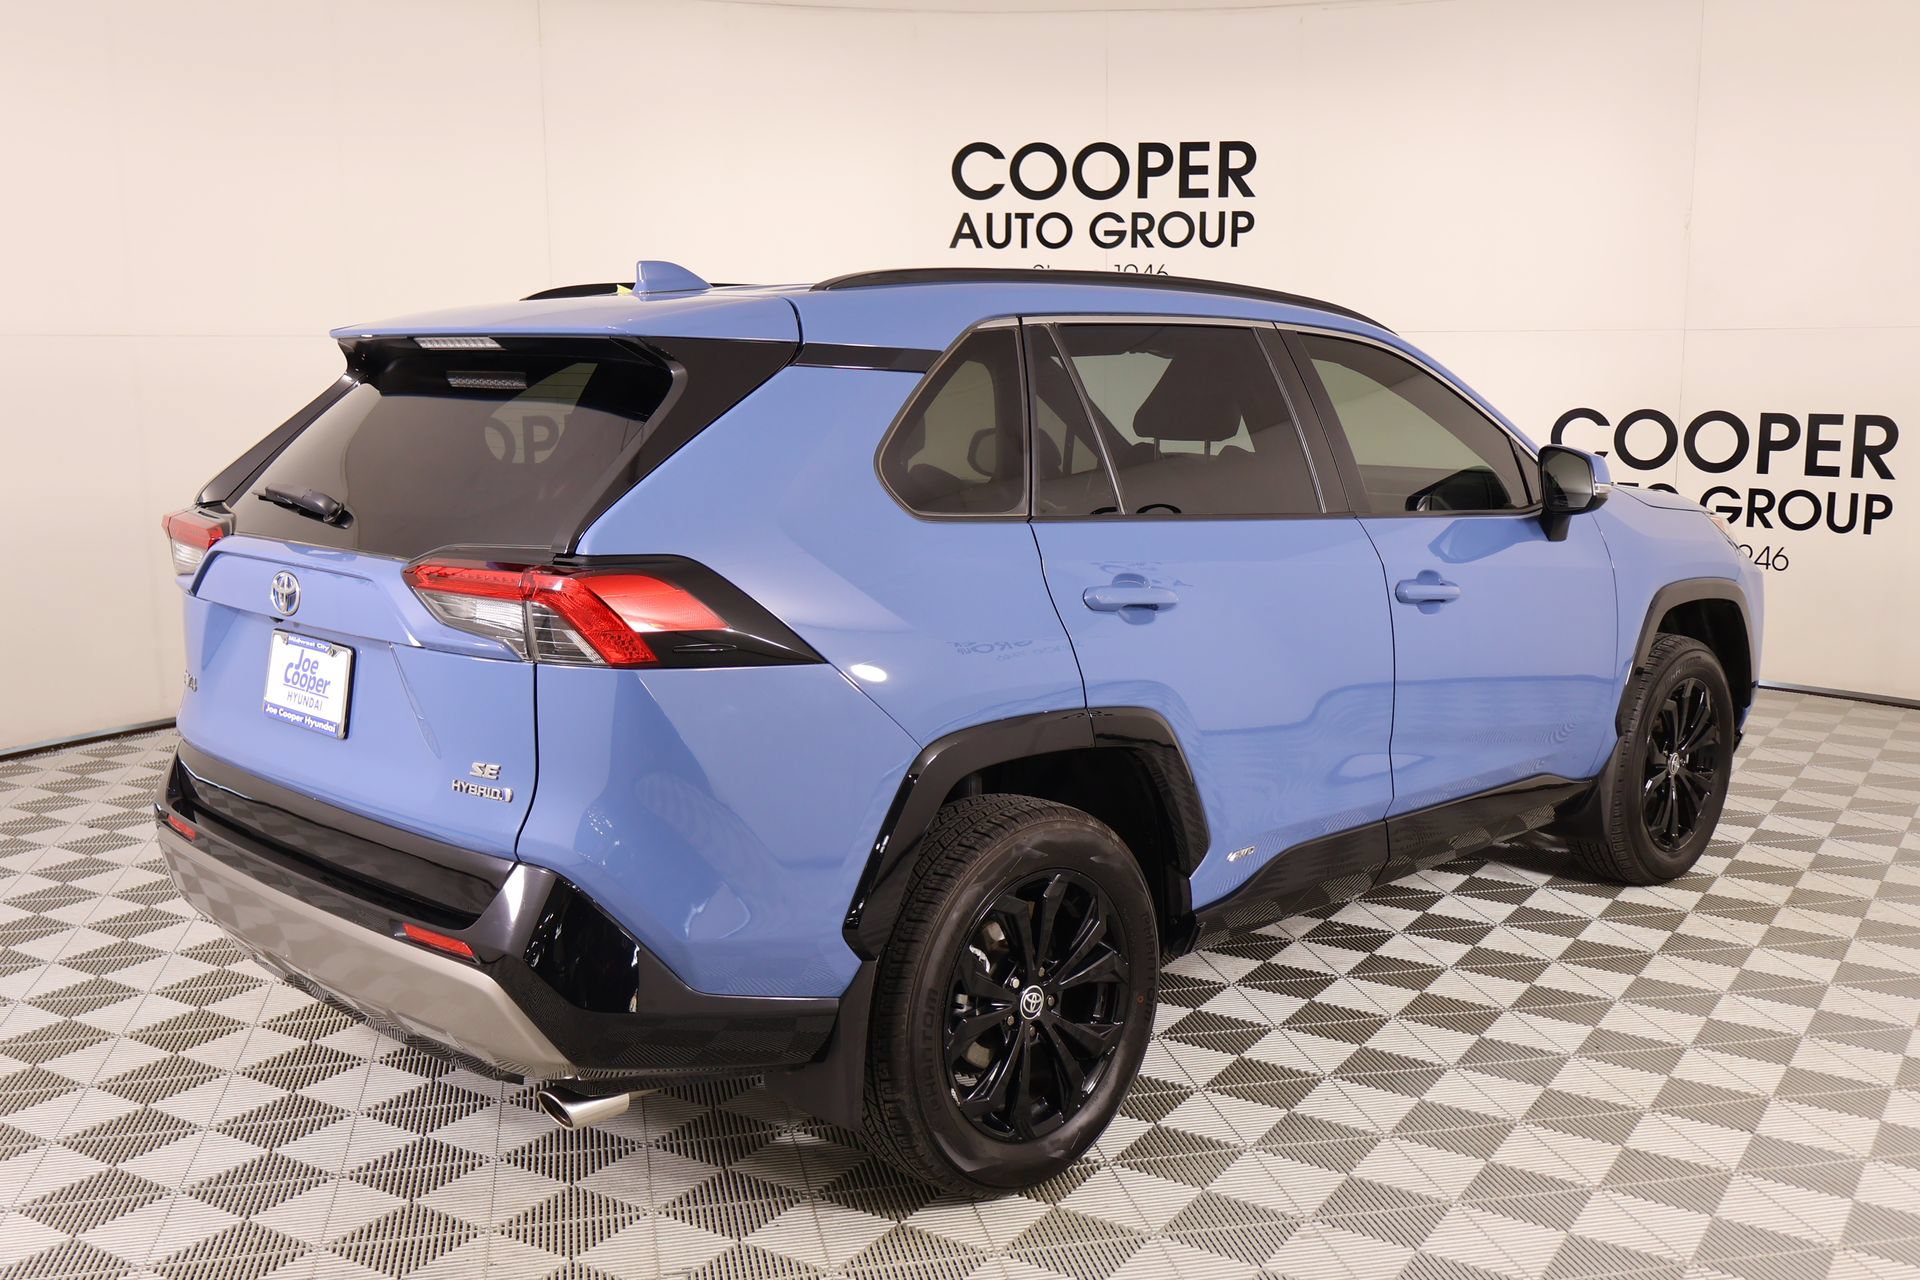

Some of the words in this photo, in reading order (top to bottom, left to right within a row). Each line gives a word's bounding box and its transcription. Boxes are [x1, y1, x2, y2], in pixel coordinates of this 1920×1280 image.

[952, 141, 1257, 200] COOPER
[949, 212, 1073, 249] AUTO
[1089, 211, 1255, 249] GROUP
[1550, 407, 1900, 480] COOPER
[1699, 485, 1894, 535] GROUP
[317, 640, 330, 652] City
[294, 649, 319, 675] Joe
[284, 662, 331, 694] Cooper
[287, 691, 323, 711] HYUNDAI
[266, 703, 278, 715] Joe
[279, 706, 304, 723] Cooper
[305, 716, 337, 733] Hyundai
[469, 762, 501, 780] SE
[451, 779, 501, 801] HYBRID
